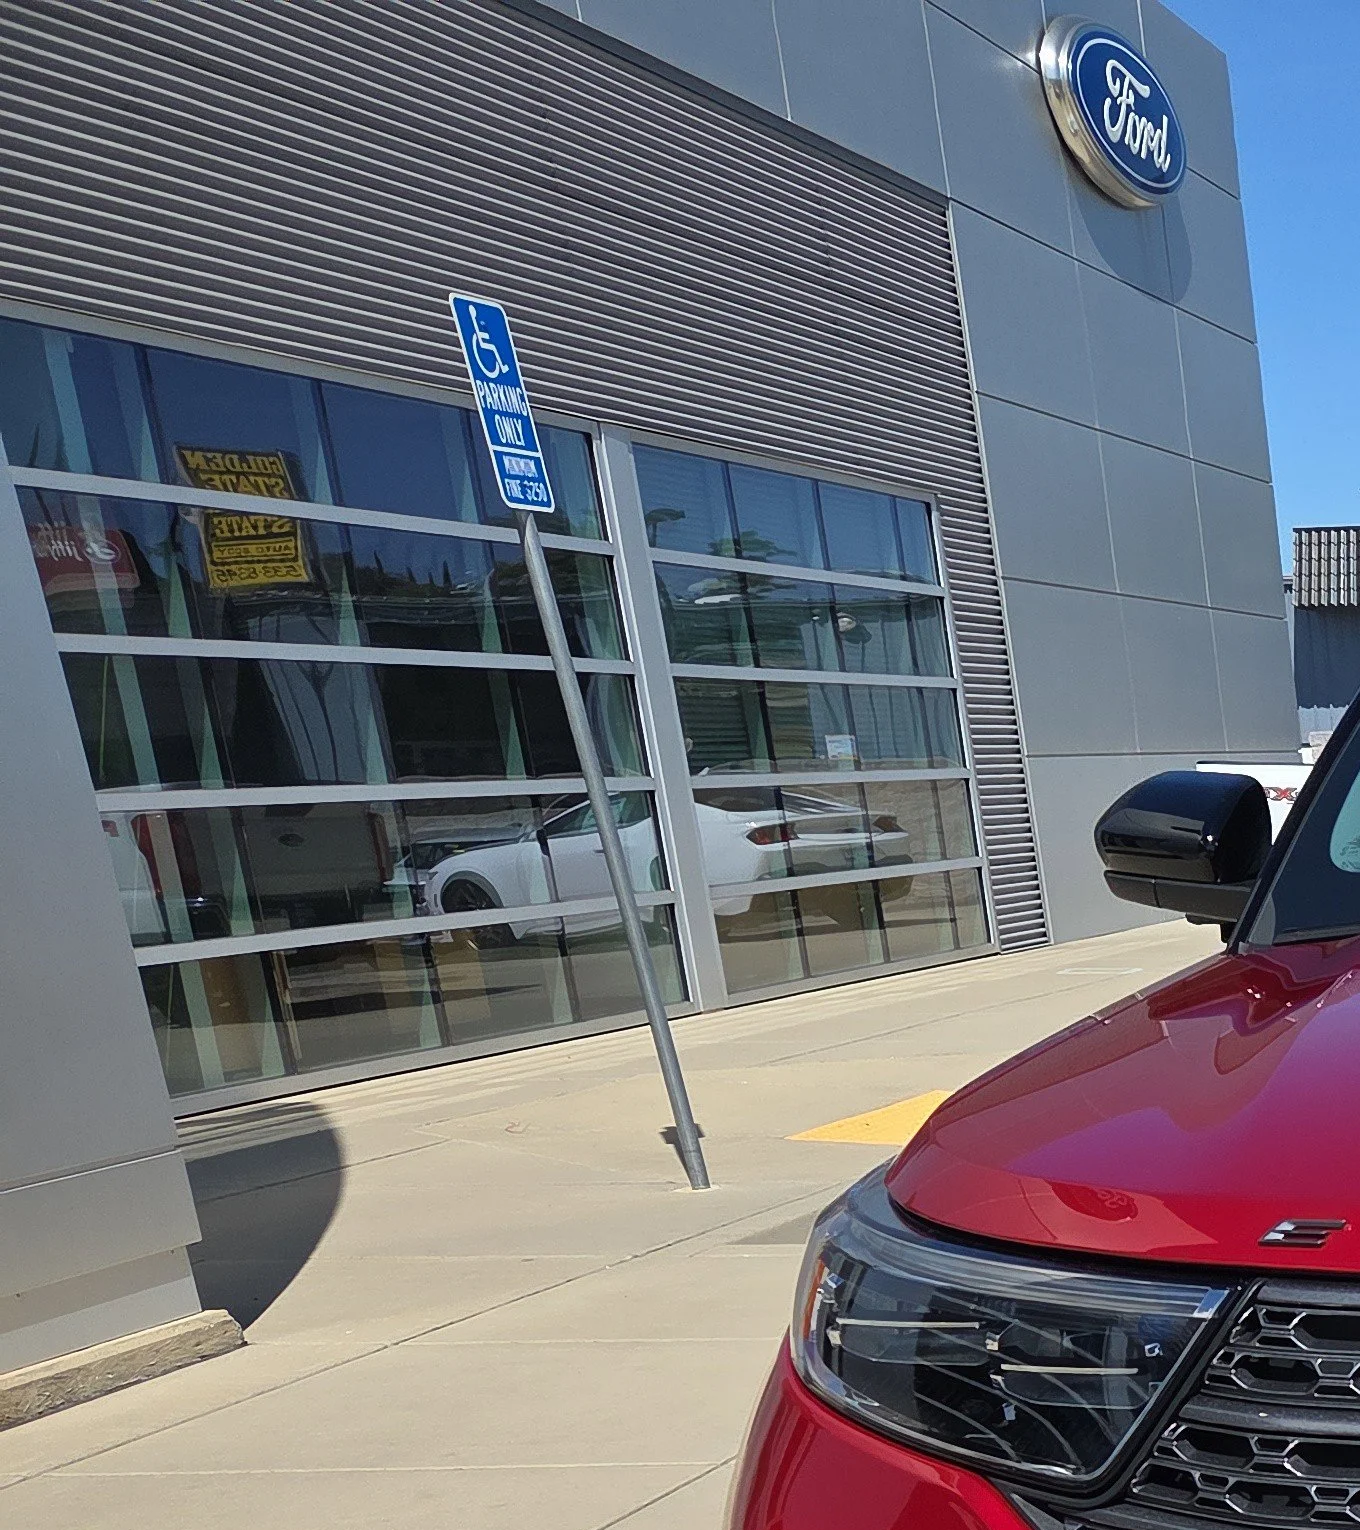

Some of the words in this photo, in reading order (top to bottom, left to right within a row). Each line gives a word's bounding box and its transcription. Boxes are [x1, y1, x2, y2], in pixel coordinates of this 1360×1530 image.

[1103, 59, 1171, 172] Ford
[476, 380, 528, 417] PARKING
[495, 414, 525, 446] ONLY
